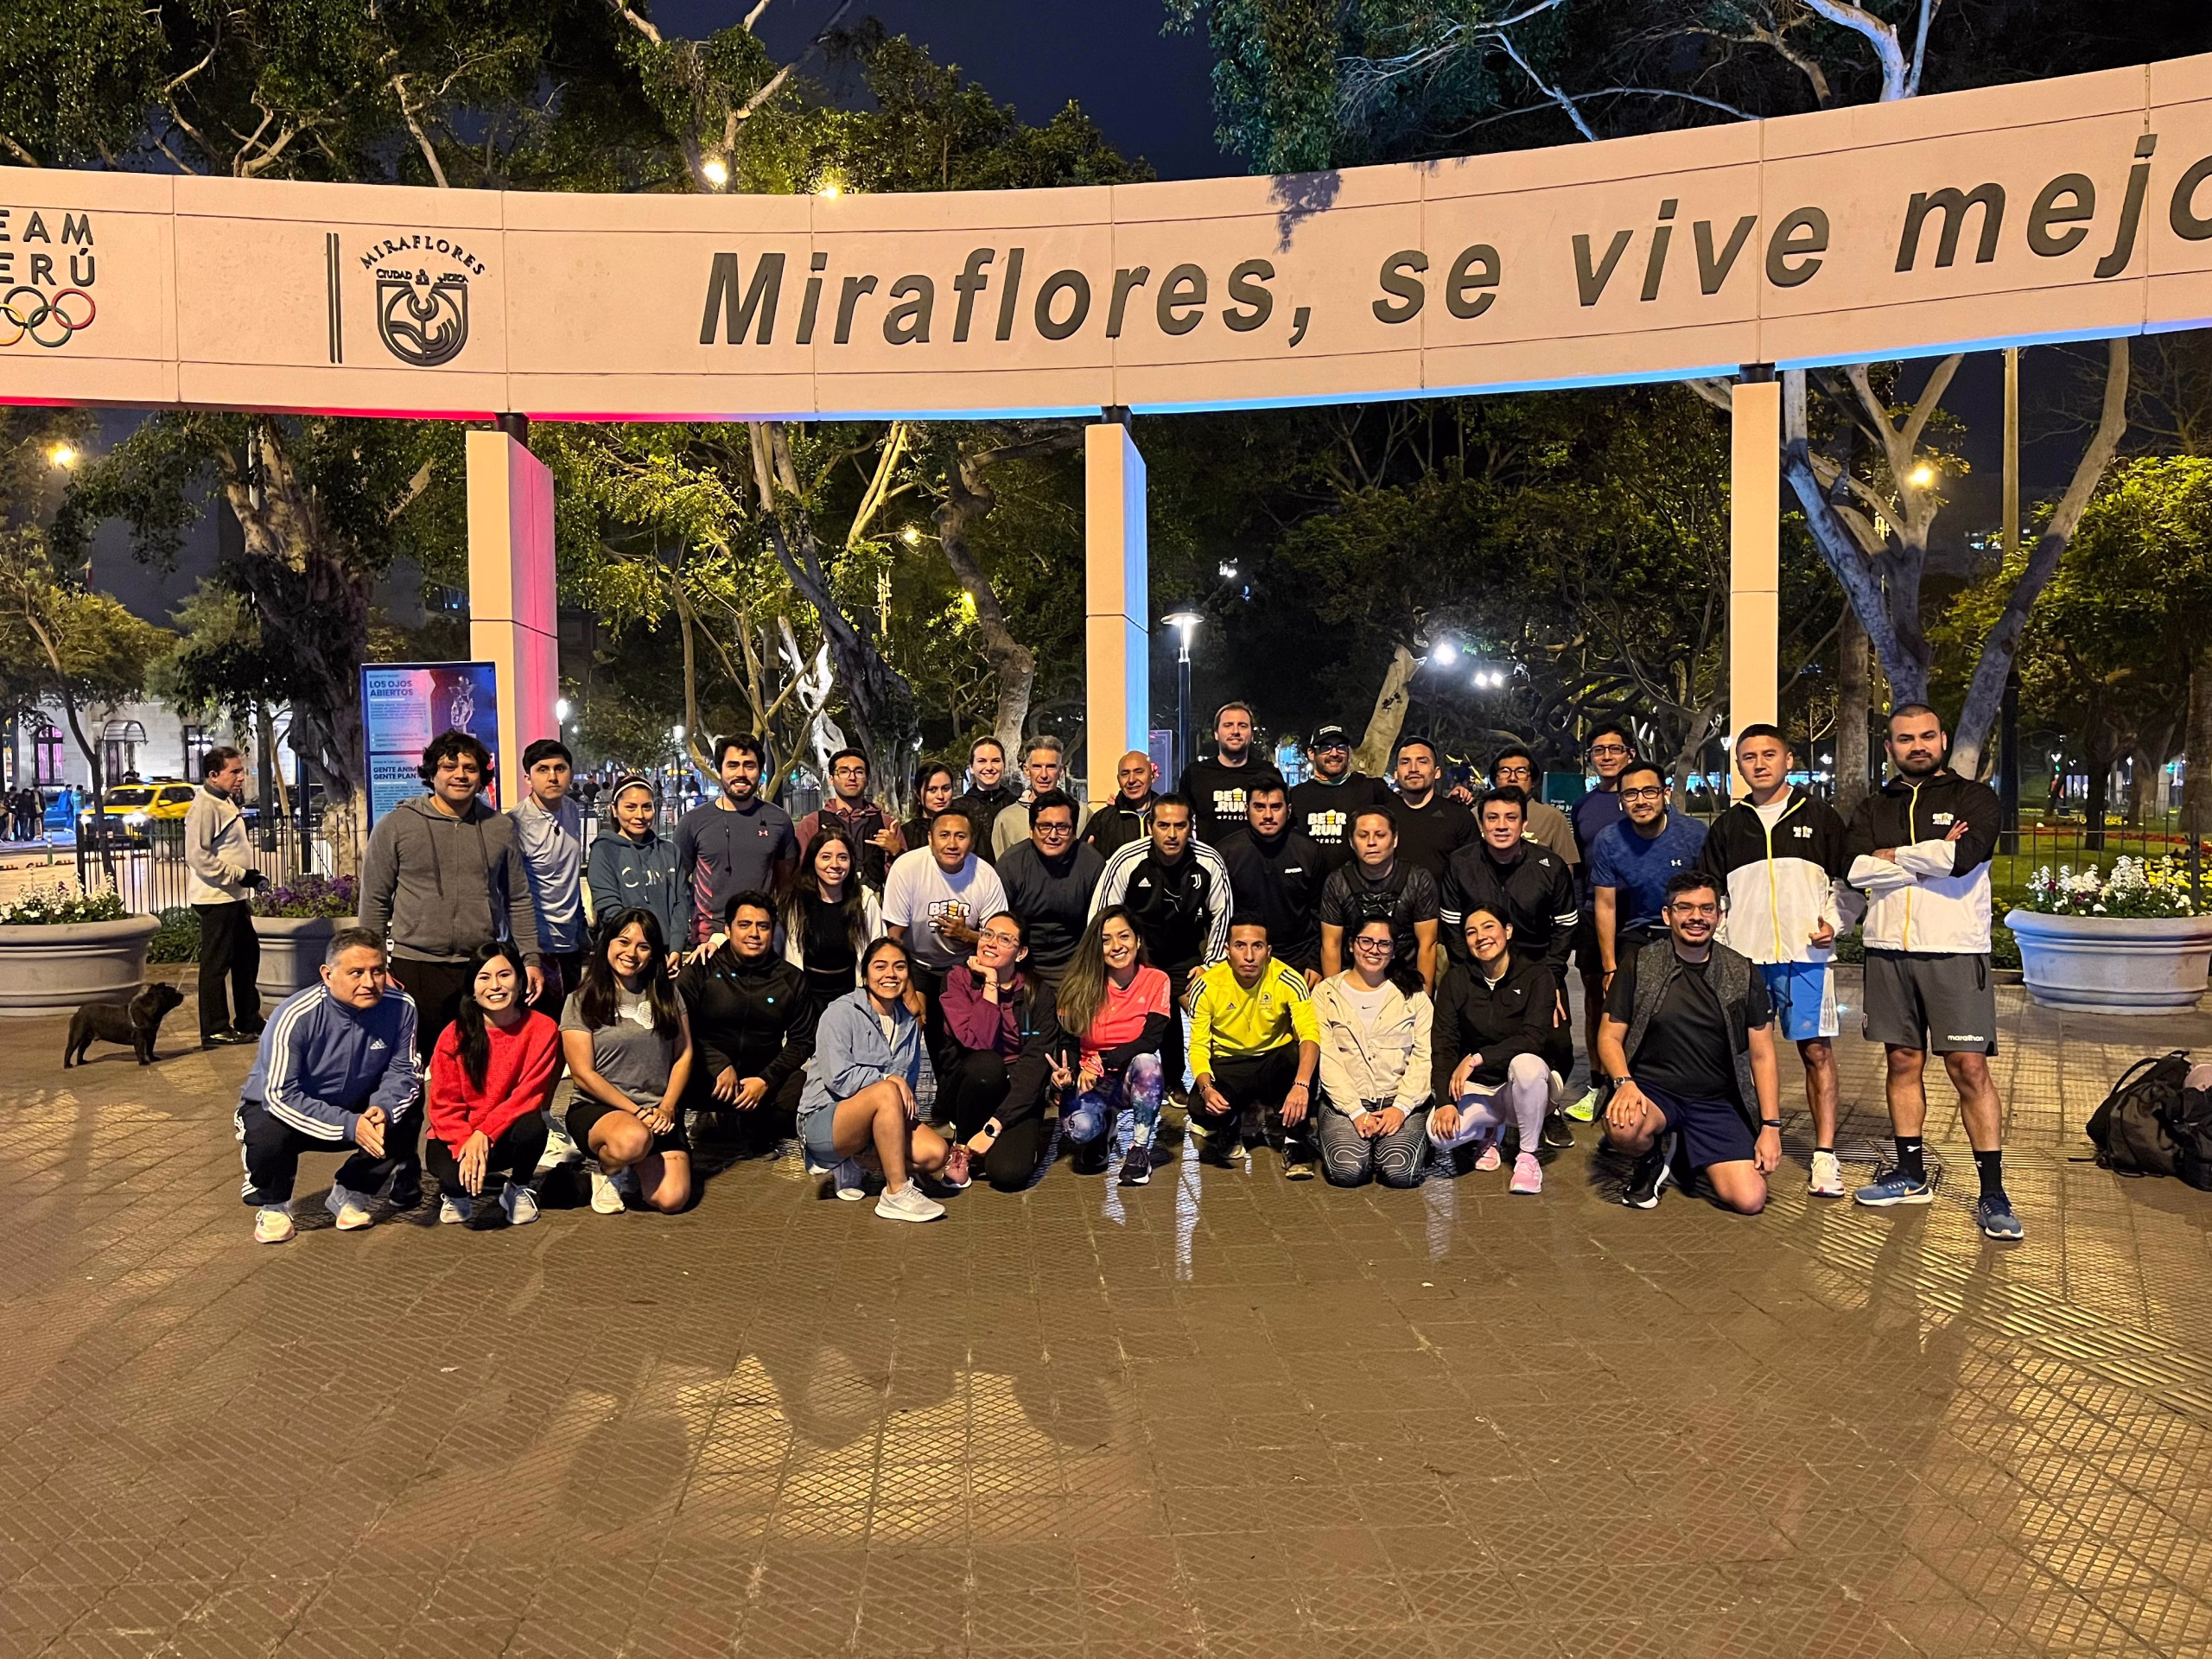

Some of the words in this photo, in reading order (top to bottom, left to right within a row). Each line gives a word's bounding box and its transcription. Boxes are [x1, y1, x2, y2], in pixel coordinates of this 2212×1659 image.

[359, 234, 486, 276] MIRAFLORES
[376, 268, 413, 280] CIUDAD
[699, 246, 1311, 347] Miraflores,
[1371, 244, 1502, 324] se
[1572, 198, 1830, 308] vive
[370, 680, 386, 689] LOS
[1308, 824, 1343, 836] RUN
